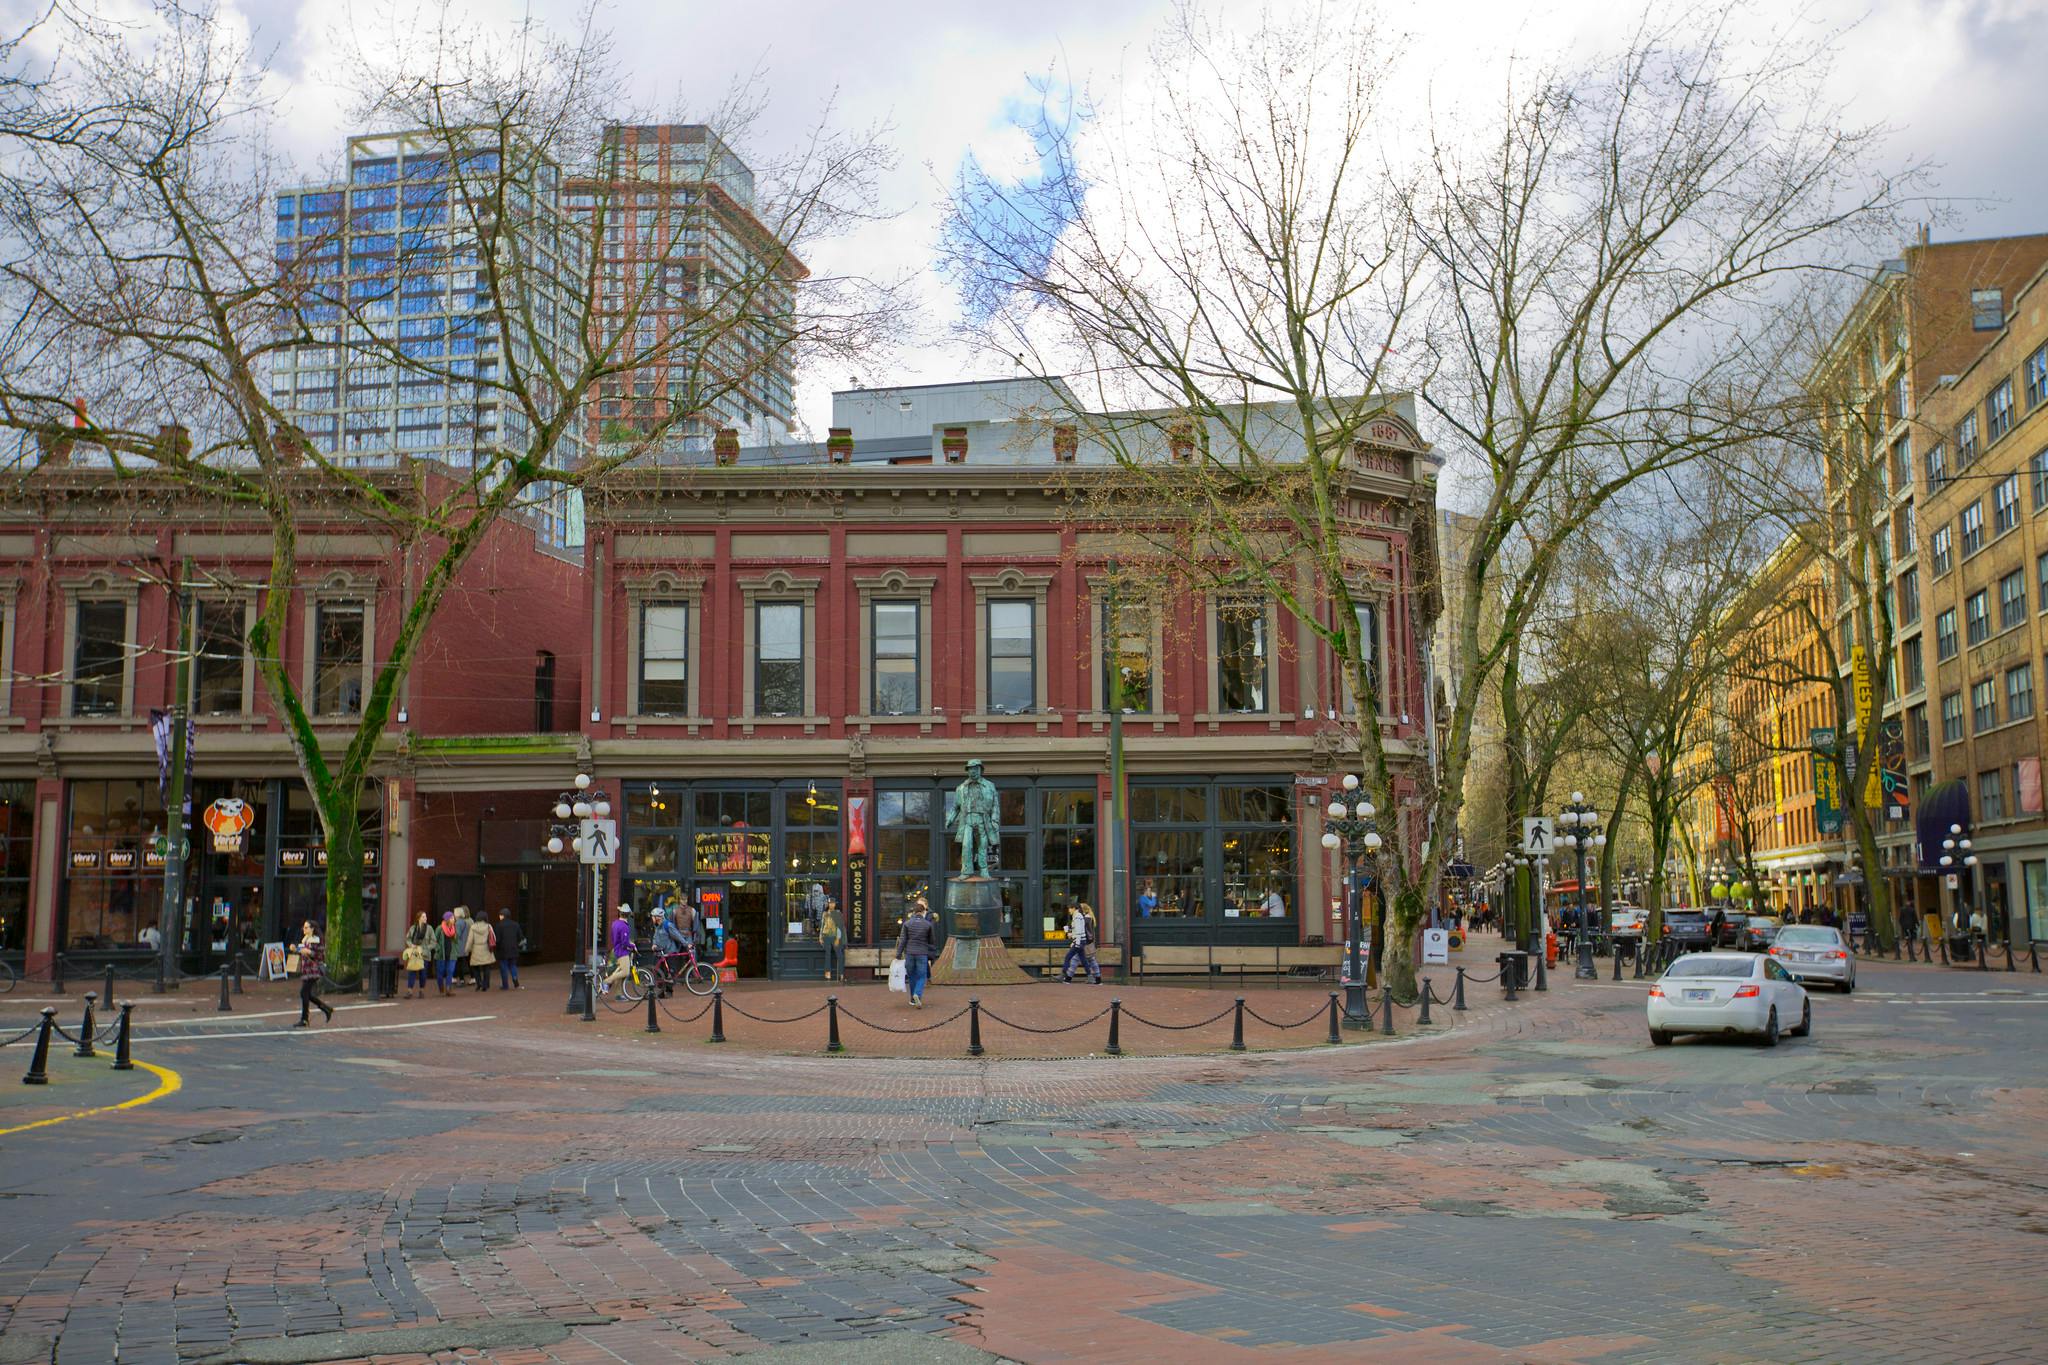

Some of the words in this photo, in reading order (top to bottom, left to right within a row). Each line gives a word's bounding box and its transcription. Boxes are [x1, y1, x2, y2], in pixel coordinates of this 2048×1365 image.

[698, 843, 740, 854] WESTERN
[74, 852, 97, 863] Vera's
[110, 852, 133, 863] Vera's
[282, 850, 305, 861] Vera's
[850, 860, 866, 870] OK
[853, 871, 862, 896] BOOT
[702, 893, 721, 902] OPEN
[853, 900, 862, 938] CORRAL
